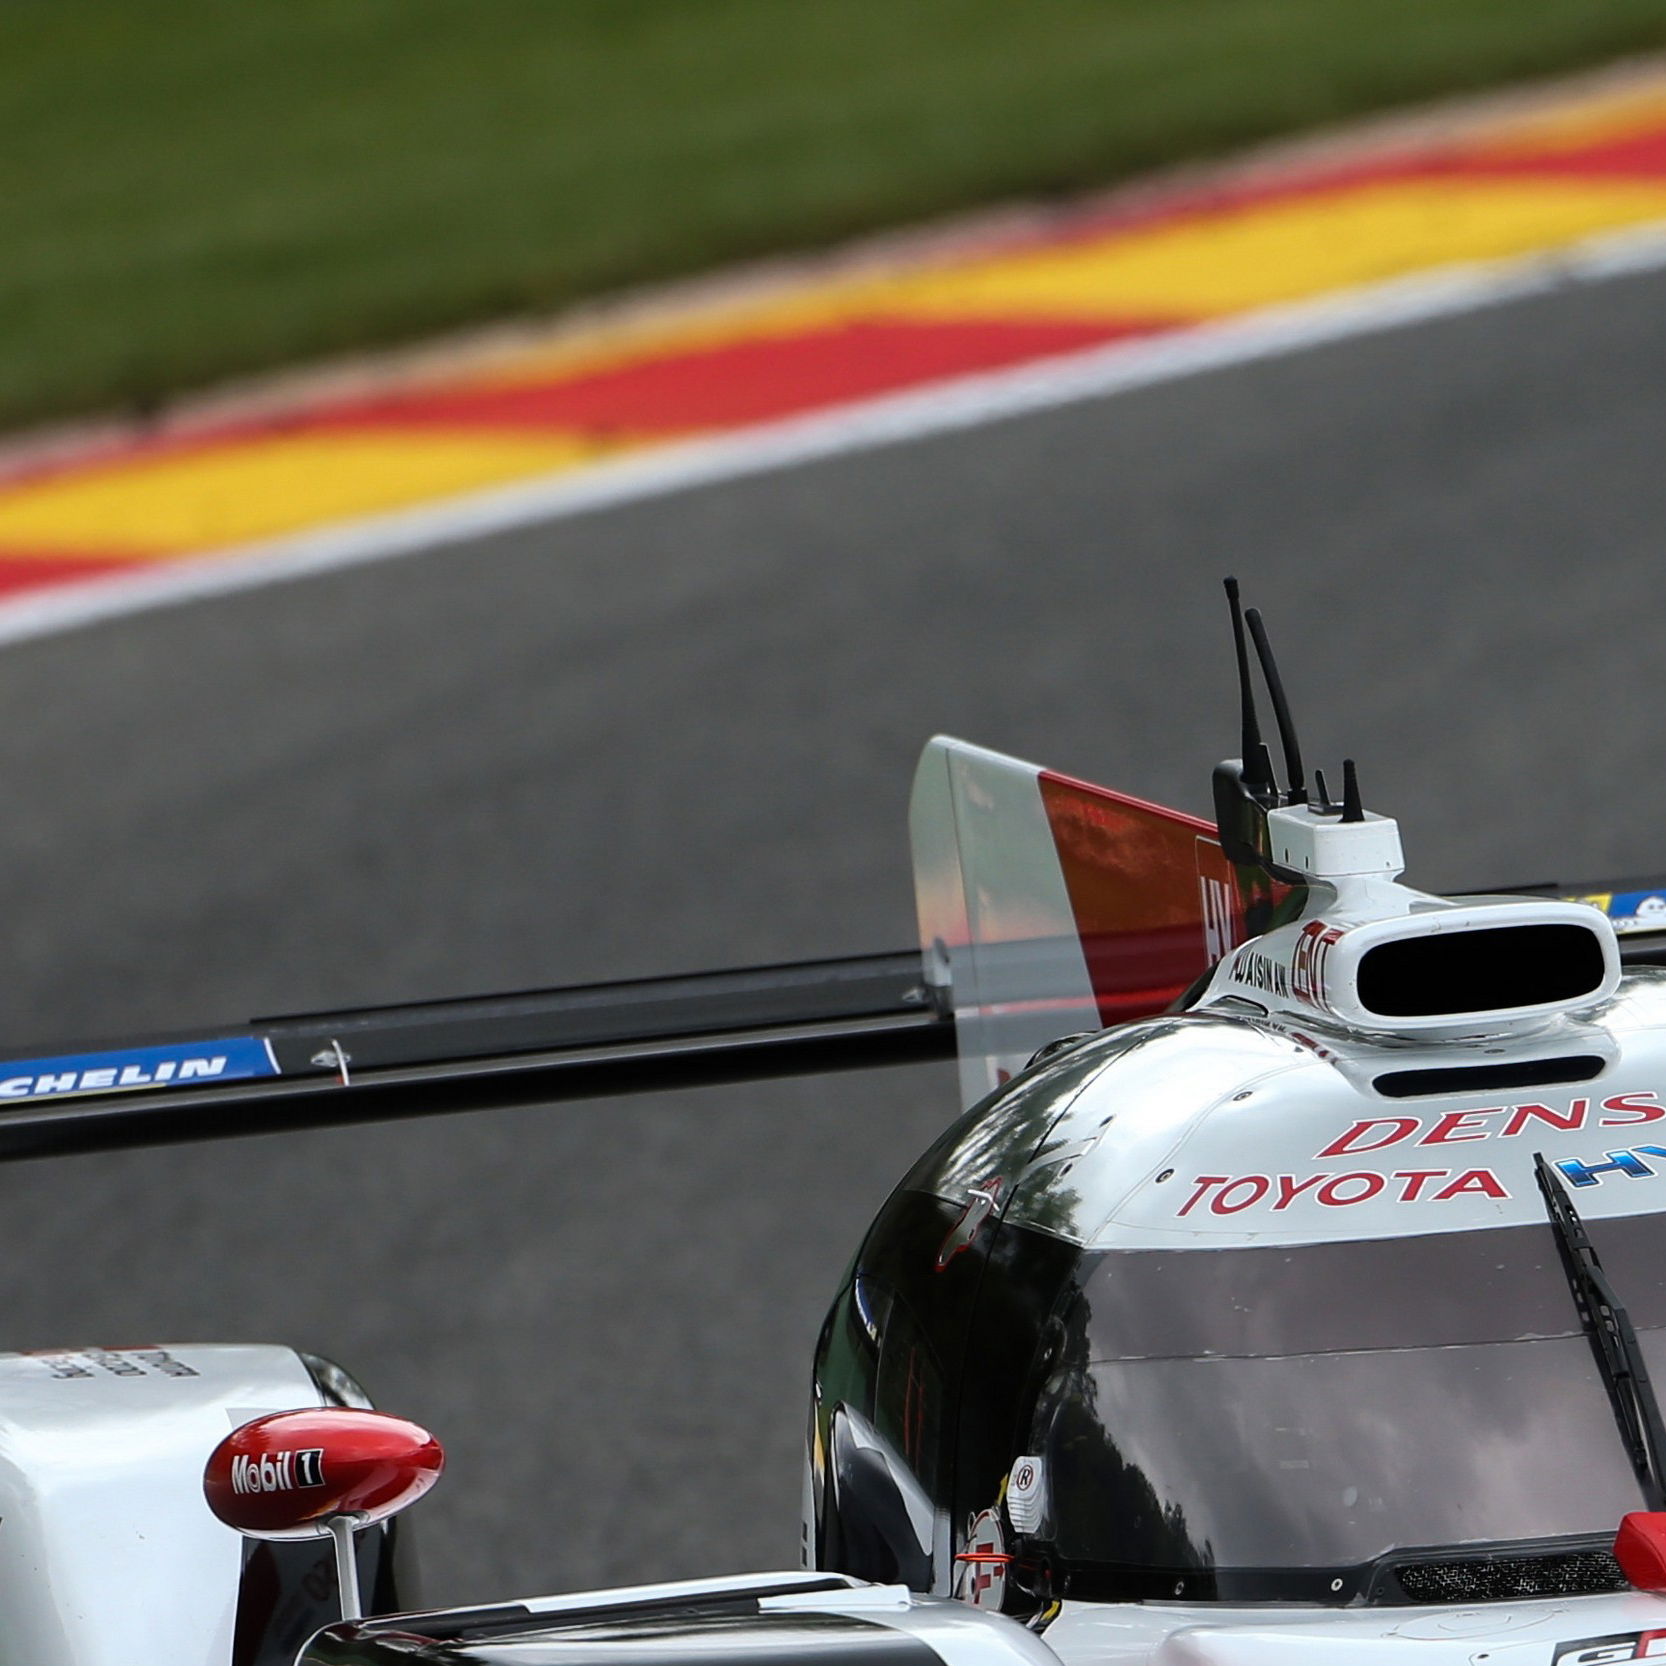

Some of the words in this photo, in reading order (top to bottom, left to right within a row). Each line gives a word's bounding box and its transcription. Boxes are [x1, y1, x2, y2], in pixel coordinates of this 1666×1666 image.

[0, 1056, 227, 1098] CHELIN
[1176, 1170, 1511, 1218] TOYOTA
[231, 1451, 294, 1494] Mobil
[301, 1452, 314, 1485] 1
